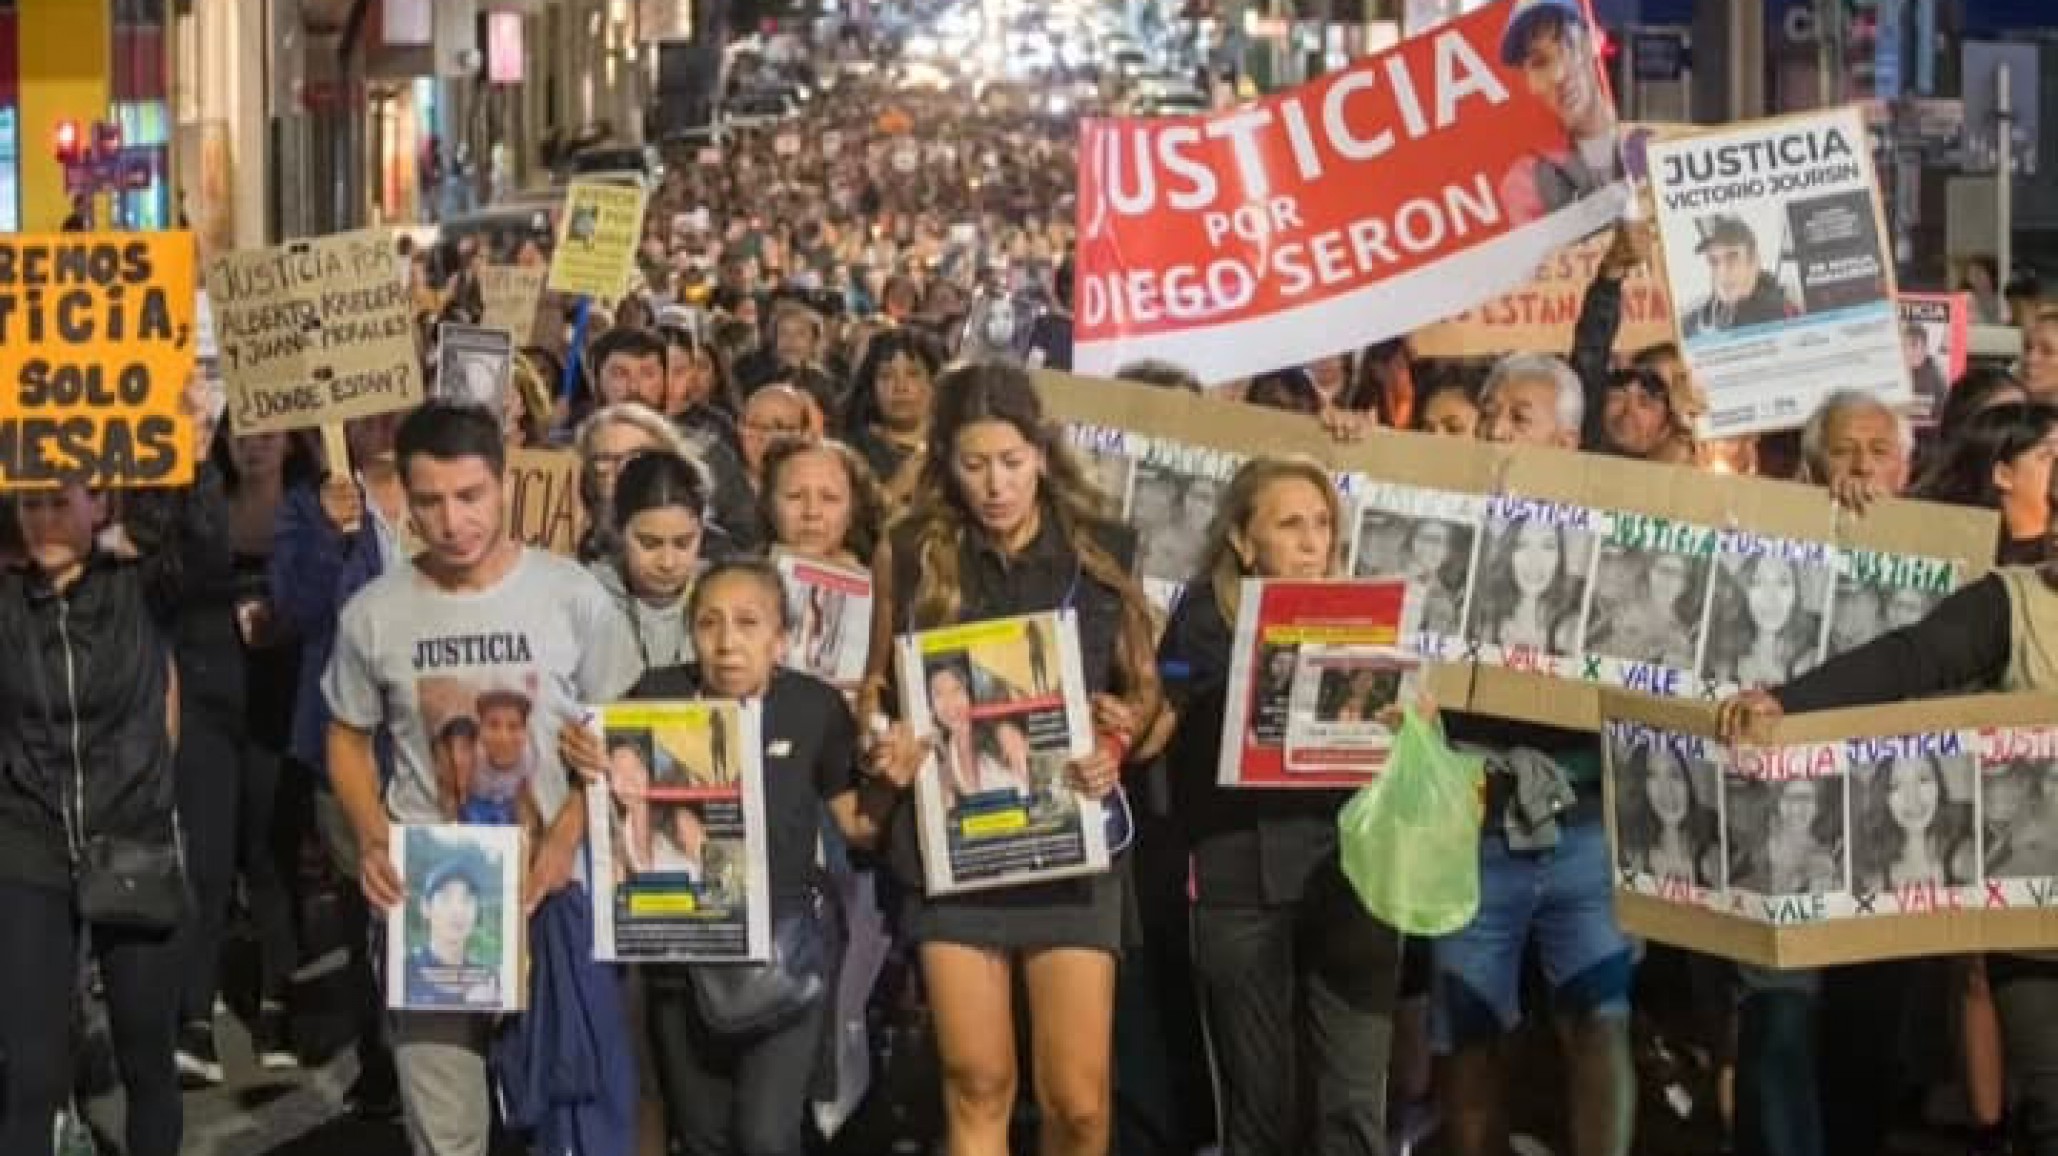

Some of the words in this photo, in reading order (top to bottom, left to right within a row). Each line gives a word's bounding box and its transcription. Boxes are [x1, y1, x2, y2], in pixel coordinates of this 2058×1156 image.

[1086, 28, 1509, 239] JUSTICIA
[1663, 128, 1852, 187] JUSTICIA
[1665, 178, 1765, 211] VICTORIO
[1204, 196, 1304, 248] POR
[213, 250, 342, 299] JUSTICIA
[1084, 257, 1256, 329] DIEGO
[1271, 172, 1501, 298] SERON
[19, 358, 151, 407] SOLO
[411, 631, 533, 669] JUSTICIA
[1621, 660, 1679, 697] VALE
[1846, 730, 1959, 761] JUSTICIA
[1762, 895, 1826, 922] VALE
